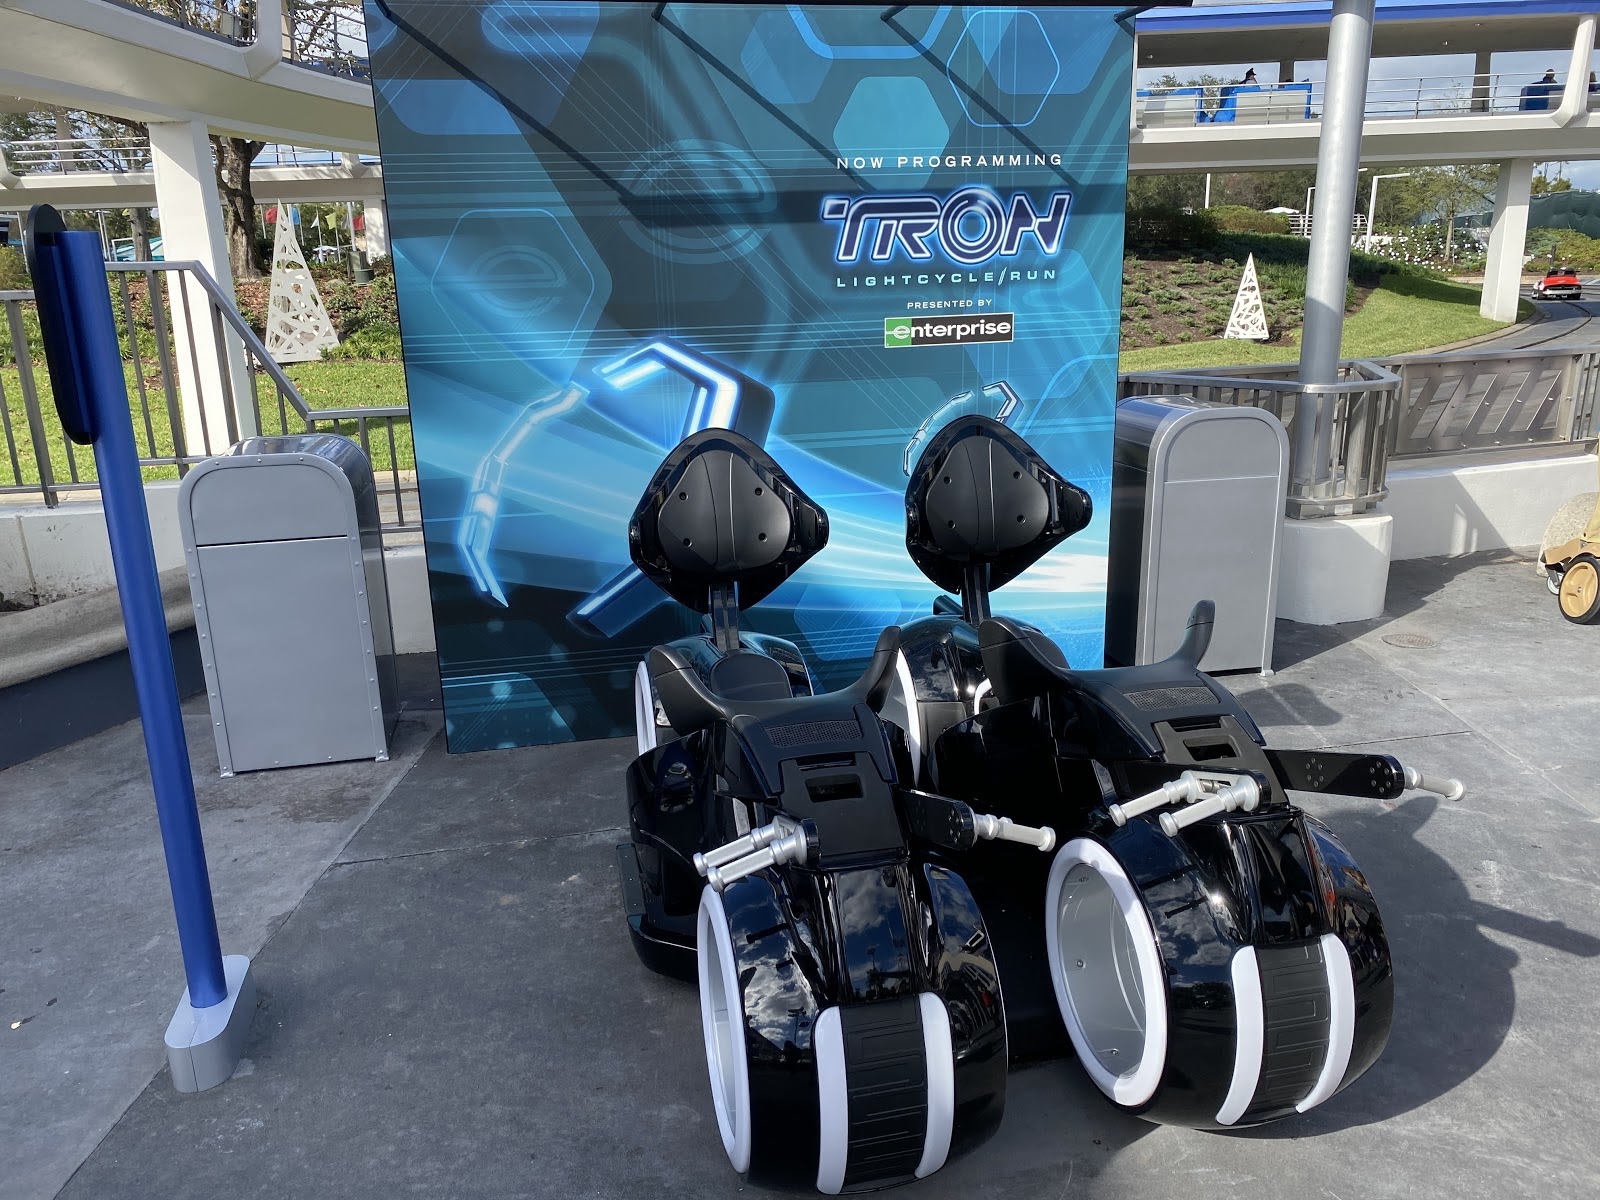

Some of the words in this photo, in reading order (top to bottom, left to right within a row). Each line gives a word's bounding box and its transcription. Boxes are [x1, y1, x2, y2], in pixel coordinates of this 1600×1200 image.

[836, 157, 884, 169] NOW
[897, 153, 1062, 168] PROGRAMMING
[822, 186, 1072, 265] TRON
[906, 299, 973, 310] PRESENTED
[977, 298, 993, 307] BY
[889, 318, 1012, 340] enterprise
